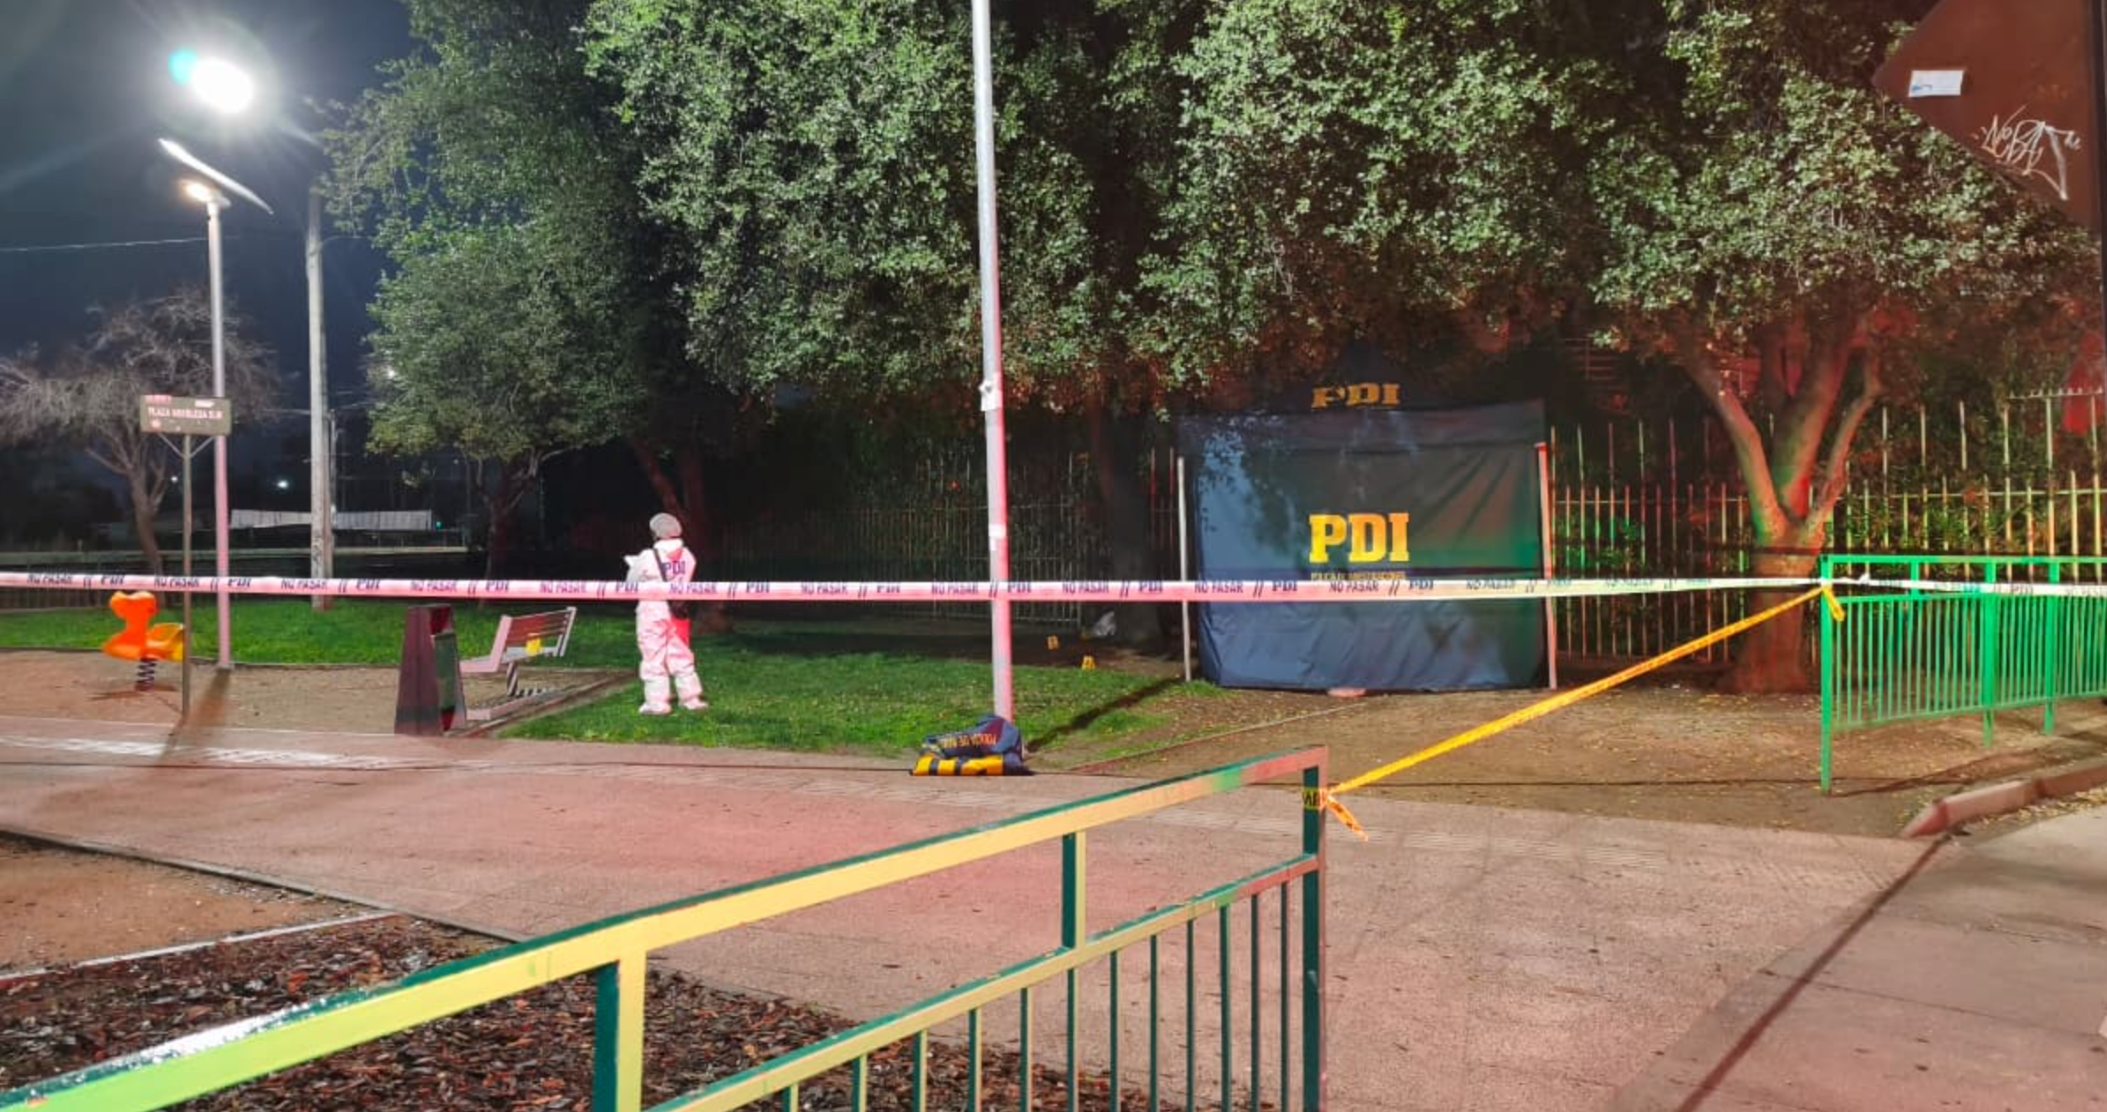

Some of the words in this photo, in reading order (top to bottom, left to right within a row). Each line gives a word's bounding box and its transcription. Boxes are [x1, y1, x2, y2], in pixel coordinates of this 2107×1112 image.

[1311, 383, 1400, 409] PDI
[1308, 512, 1410, 564] PDI
[661, 561, 686, 575] PDI
[1062, 582, 1076, 594] NO
[1138, 581, 1163, 593] PDI
[1194, 582, 1208, 594] NO
[1271, 580, 1298, 592] PDI
[1329, 580, 1344, 593] NO
[1408, 579, 1434, 591] PDI
